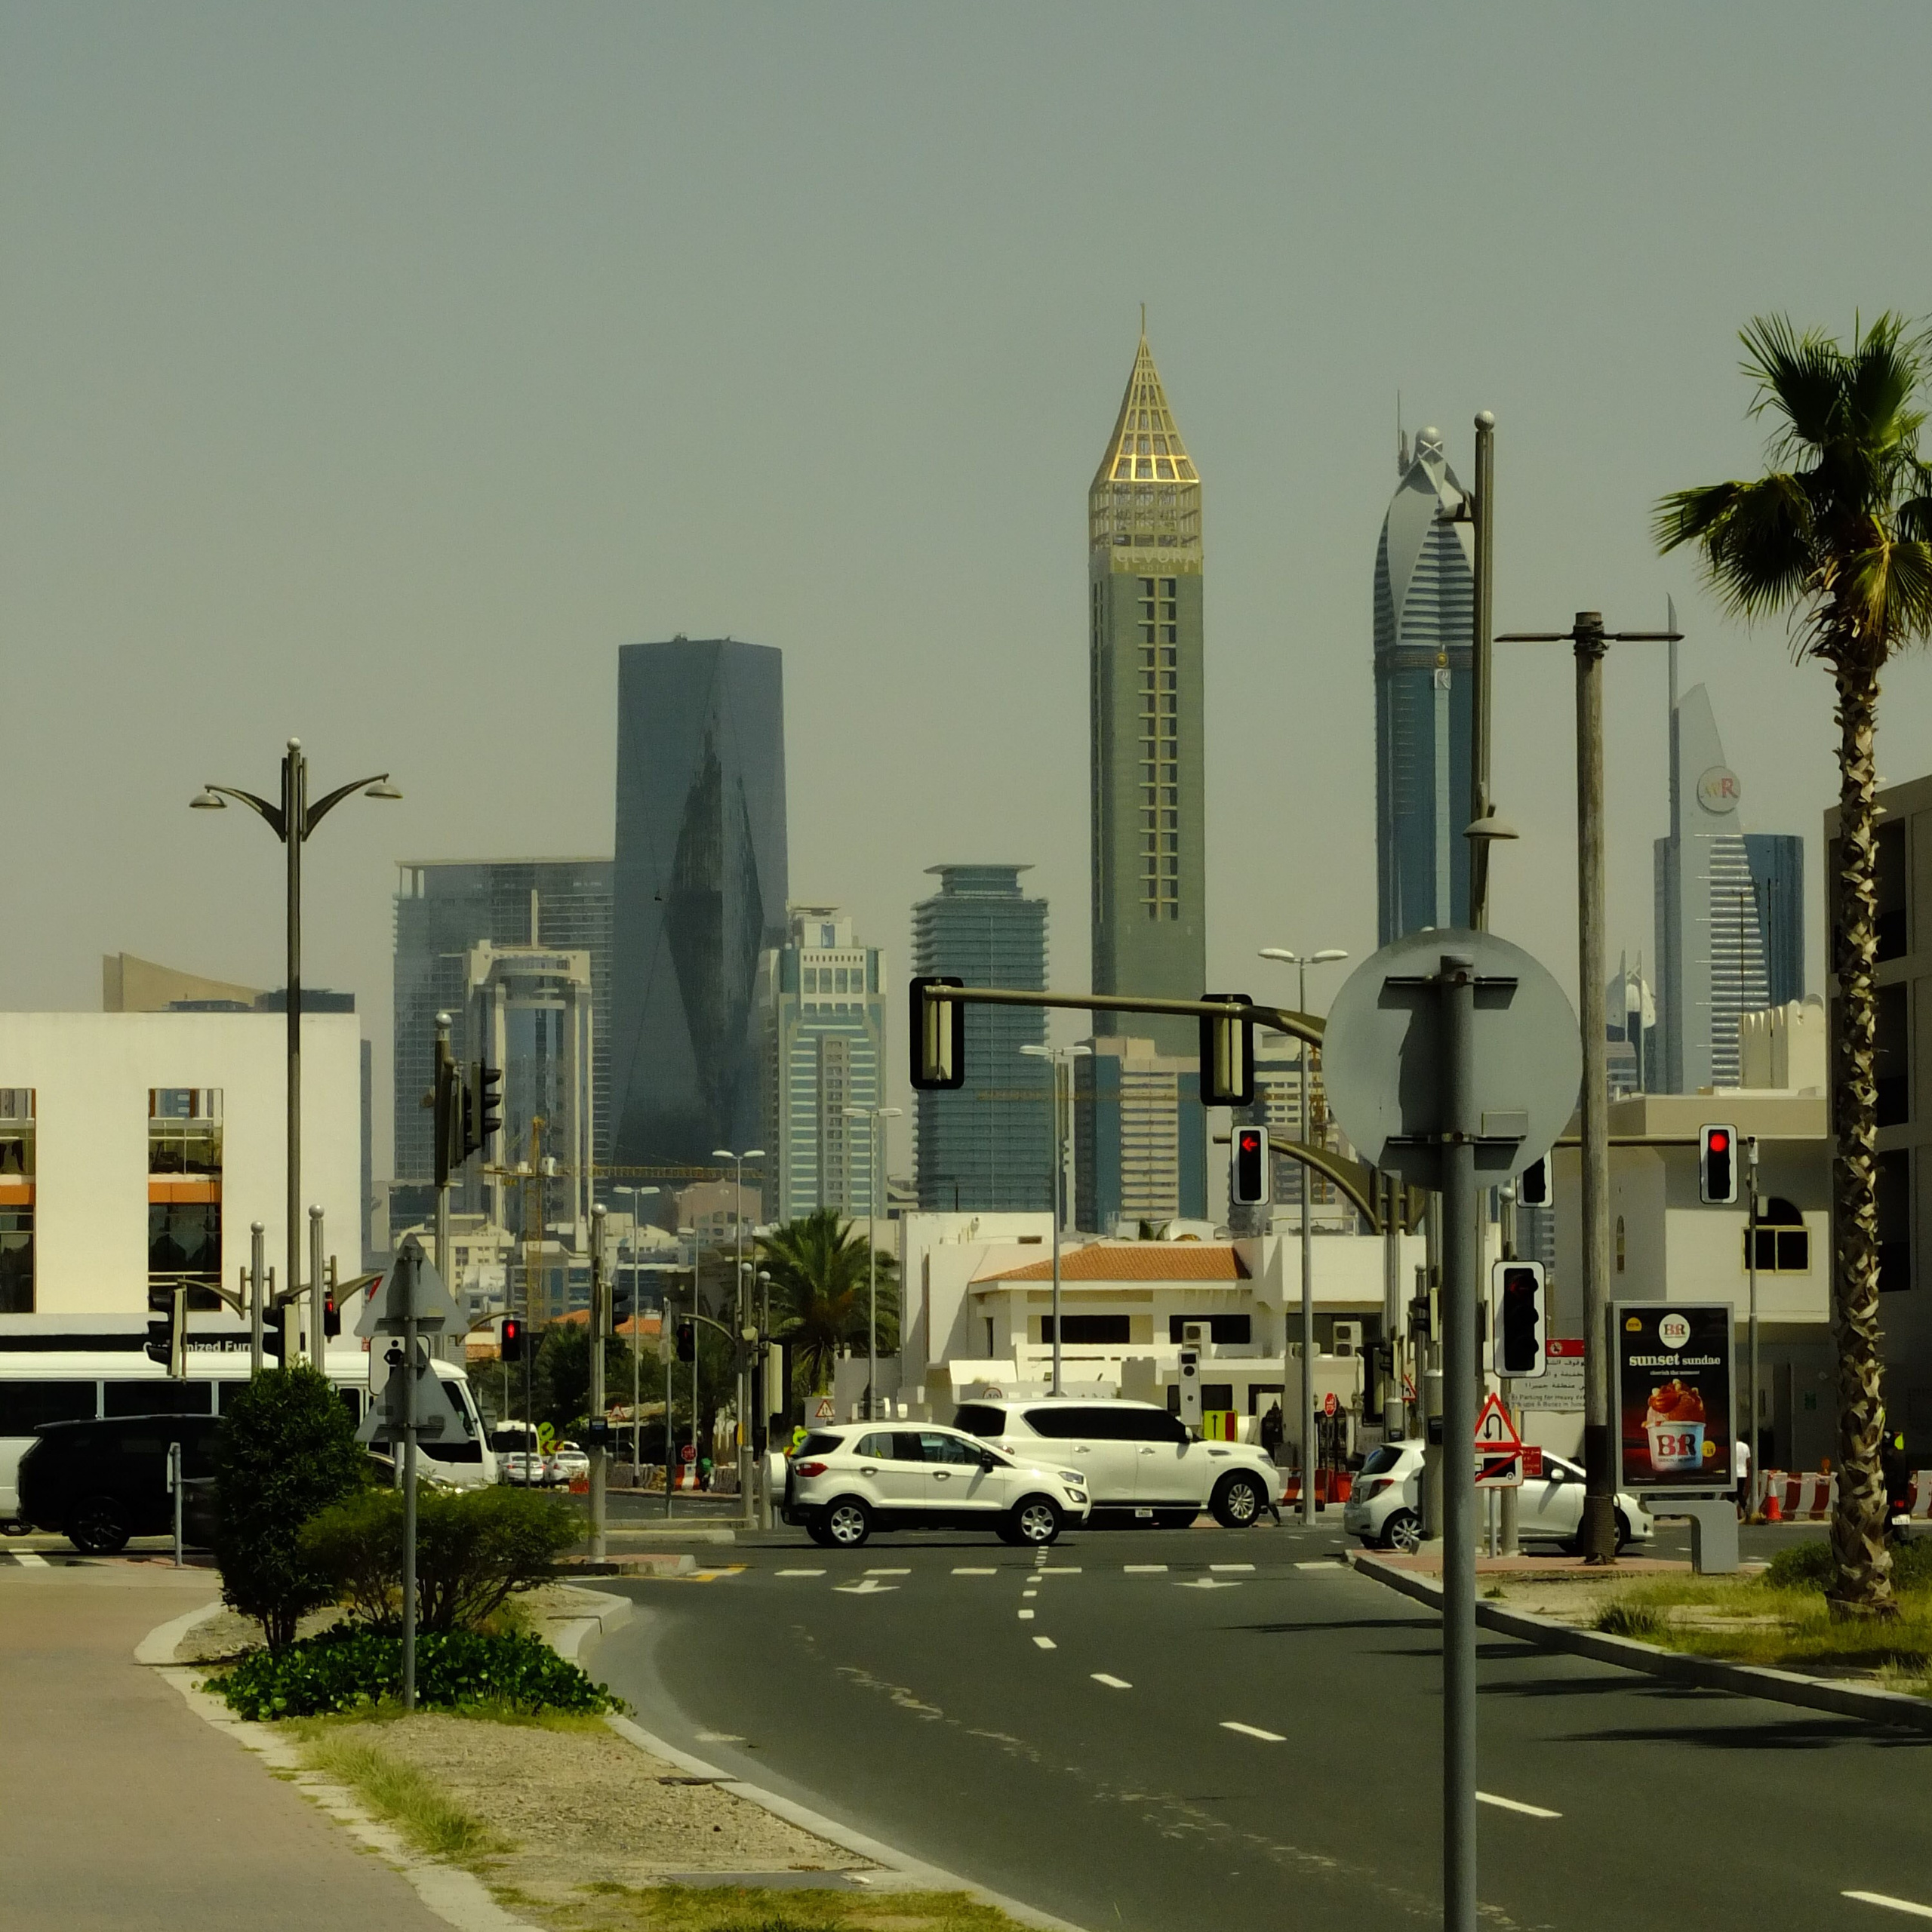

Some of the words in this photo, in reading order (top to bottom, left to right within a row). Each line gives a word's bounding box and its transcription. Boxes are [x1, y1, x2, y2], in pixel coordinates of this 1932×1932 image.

[1117, 548, 1198, 563] GEVORA
[1629, 1352, 1681, 1367] sunset
[1681, 1355, 1721, 1365] sundae
[1657, 1433, 1697, 1457] BR
